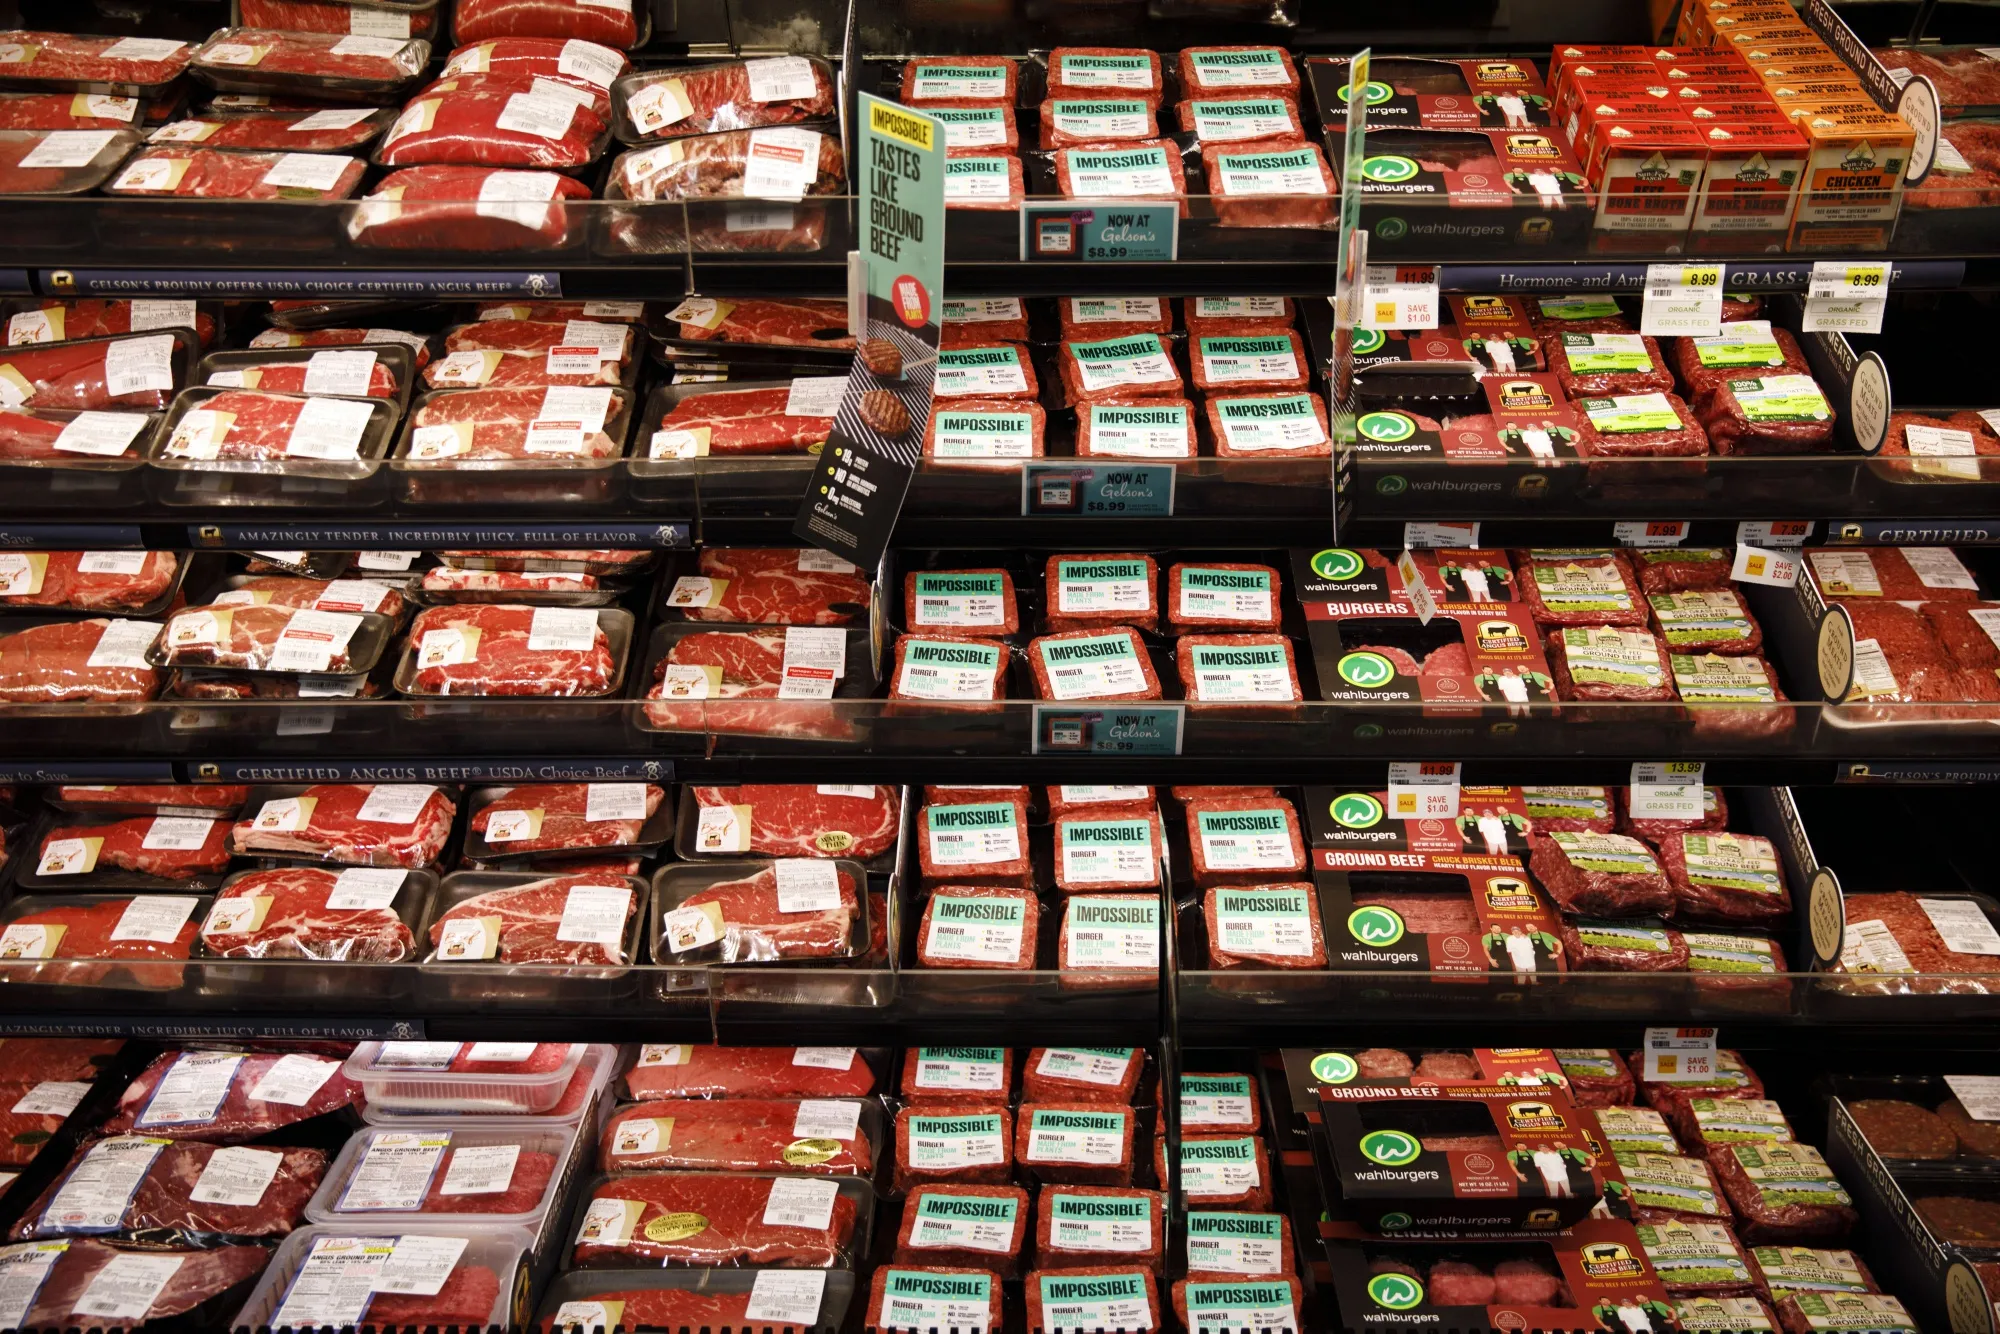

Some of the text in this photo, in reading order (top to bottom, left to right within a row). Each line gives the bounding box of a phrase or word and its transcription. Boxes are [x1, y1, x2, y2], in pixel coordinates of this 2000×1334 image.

[1810, 0, 1895, 103] FRESH GROUND MEATS
[924, 69, 998, 78] IMPOSSIBLE
[874, 108, 928, 145] IMPOSSIBLE
[871, 137, 920, 181] TASTES
[1076, 151, 1160, 168] IMPOSSIBLE
[1227, 153, 1310, 169] IMPOSSIBLE
[871, 169, 898, 203] LIKE
[1826, 176, 1880, 187] CHICKEN
[871, 198, 923, 243] GROUND
[1108, 215, 1150, 227] NOW AT
[1101, 225, 1155, 244] Gelson's
[1412, 223, 1504, 236] wahlburgers
[871, 226, 901, 263] BEEF
[1088, 247, 1127, 258] $8.99
[1404, 271, 1435, 284] 11.99
[1500, 274, 1577, 288] Hormone-
[1582, 273, 1610, 287] and
[1690, 273, 1717, 285] 8.99
[1853, 274, 1879, 286] 8.99
[90, 280, 149, 289] GELSON'S
[155, 281, 212, 289] PROUDLY
[217, 281, 263, 290] OFFERS
[267, 282, 300, 290] USDA
[306, 282, 353, 291] CHOICE
[359, 282, 424, 291] CERTIFIED
[430, 282, 471, 291] ANGUS
[899, 282, 917, 296] MADE
[903, 295, 921, 311] FROM
[1407, 304, 1428, 313] SAVE
[905, 308, 923, 320] PLANTS
[1407, 313, 1430, 323] $1.00
[1816, 318, 1868, 326] GRASS FED
[1209, 340, 1285, 353] IMPOSSIBLE
[1225, 401, 1307, 417] IMPOSSIBLE
[1099, 412, 1180, 424] IMPOSSIBLE
[944, 419, 1025, 431] IMPOSSIBLE
[835, 468, 847, 483] NO
[1107, 472, 1148, 485] NOW AT
[1101, 481, 1154, 499] Gelson's
[815, 502, 838, 520] Gelson's
[1088, 501, 1125, 513] $8.99
[1652, 526, 1677, 535] 7.99
[1781, 525, 1806, 535] 7.99
[1879, 529, 1988, 542] CERTIFIED
[1, 533, 34, 544] Save
[239, 532, 641, 542] AMAZINGLY TENDER. INCREDIBLY JUICY. FULL OF FLAVOR.
[1066, 565, 1141, 578] IMPOSSIBLE
[1775, 561, 1792, 570] SAVE
[1188, 574, 1263, 588] IMPOSSIBLE
[1772, 570, 1792, 580] $2.00
[923, 579, 997, 592] IMPOSSIBLE
[1305, 582, 1377, 593] wahlburgers
[1417, 589, 1429, 607] SAVE
[1327, 603, 1408, 616] BURGERS
[913, 646, 992, 665] IMPOSSIBLE
[1049, 641, 1128, 661] IMPOSSIBLE
[1200, 650, 1280, 666] IMPOSSIBLE
[1332, 691, 1409, 702] wahlburgers
[1115, 715, 1156, 727] NOW AT
[1109, 724, 1161, 739] Gelson's
[1097, 741, 1134, 751] $8.99
[237, 769, 340, 779] CERTIFIED
[350, 768, 416, 779] ANGUS
[490, 767, 534, 778] USDA
[540, 767, 589, 778] Choice
[595, 765, 628, 778] Beef
[1423, 765, 1452, 775] 11.99
[1672, 763, 1701, 772] 13.99
[0, 770, 68, 781] ay to Save
[1945, 773, 2000, 781] PROUDLY
[1427, 804, 1448, 813] $1.00
[936, 811, 1010, 827] IMPOSSIBLE
[1206, 815, 1281, 831] IMPOSSIBLE
[820, 834, 847, 842] WAFER
[1324, 832, 1396, 841] wahlburgers
[825, 840, 846, 848] THIN
[1325, 852, 1426, 867] GROUND BEEF
[1431, 856, 1497, 866] CHUCK BRISKET
[1225, 897, 1302, 912] IMPOSSIBLE
[941, 903, 1018, 920] IMPOSSIBLE
[1076, 904, 1154, 923] IMPOSSIBLE
[1342, 951, 1418, 962] wahlburgers
[131, 1026, 211, 1034] INCREDIBLY
[264, 1028, 298, 1036] FULL
[302, 1028, 318, 1036] OF
[1332, 1087, 1441, 1098] GROUND BEEF
[917, 1119, 995, 1134] IMPOSSIBLE
[1040, 1114, 1117, 1129] IMPOSSIBLE
[1355, 1170, 1439, 1183] wahlburgers
[1836, 1108, 1940, 1269] FRESH GROUND MEATS
[1060, 1201, 1144, 1217] IMPOSSIBLE
[1416, 1215, 1511, 1226] wahlburgers
[646, 1221, 705, 1236] LONDON BROIL
[1587, 1266, 1618, 1275] ANGUS
[1589, 1260, 1632, 1270] CERTIFIED
[894, 1276, 983, 1295] IMPOSSIBLE
[1050, 1280, 1139, 1298] IMPOSSIBLE
[1196, 1287, 1285, 1304] IMPOSSIBLE
[1363, 1312, 1439, 1323] wahlburgers
